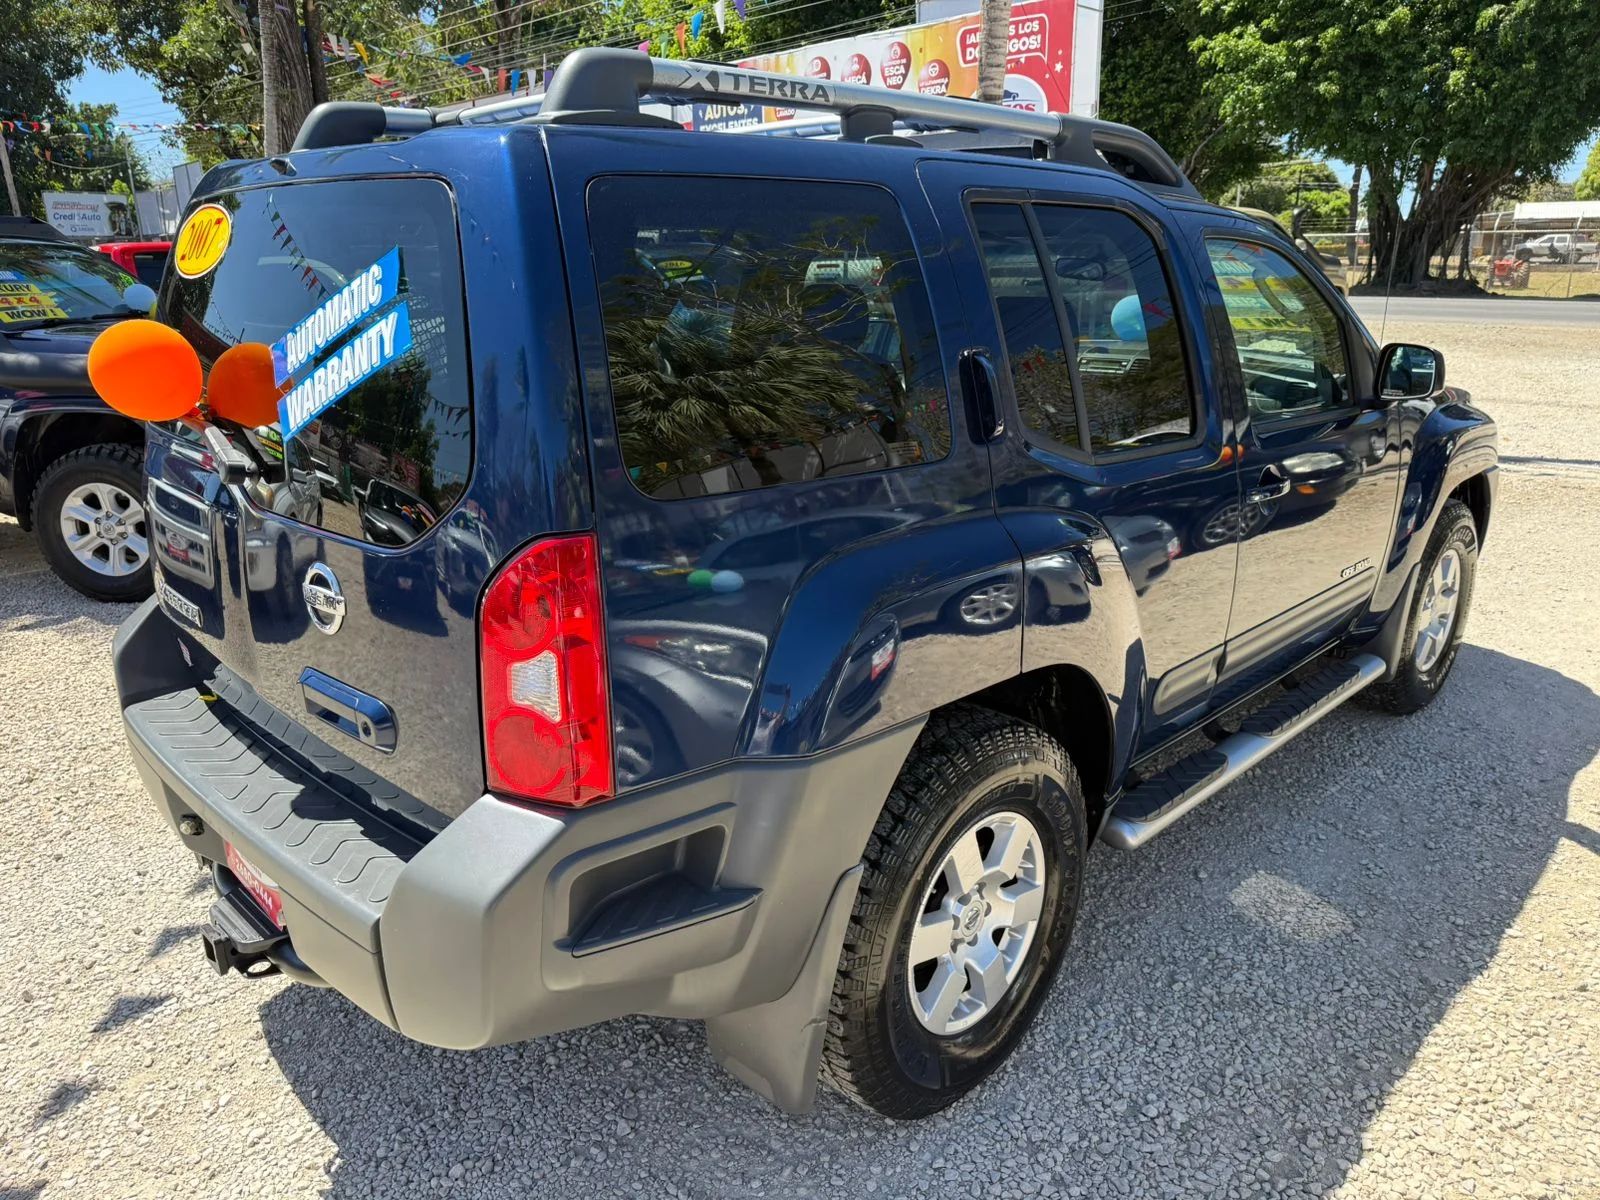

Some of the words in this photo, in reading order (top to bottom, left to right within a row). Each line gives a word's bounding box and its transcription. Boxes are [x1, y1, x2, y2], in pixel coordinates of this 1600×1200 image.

[1018, 20, 1040, 34] LOS
[965, 34, 1042, 60] DOGOS!
[884, 65, 906, 76] ESCA
[886, 76, 904, 86] NEO
[679, 69, 831, 103] XTERRA
[180, 217, 224, 261] 2007
[285, 263, 383, 374] AUTOMATIC
[285, 311, 399, 431] WARRANTY
